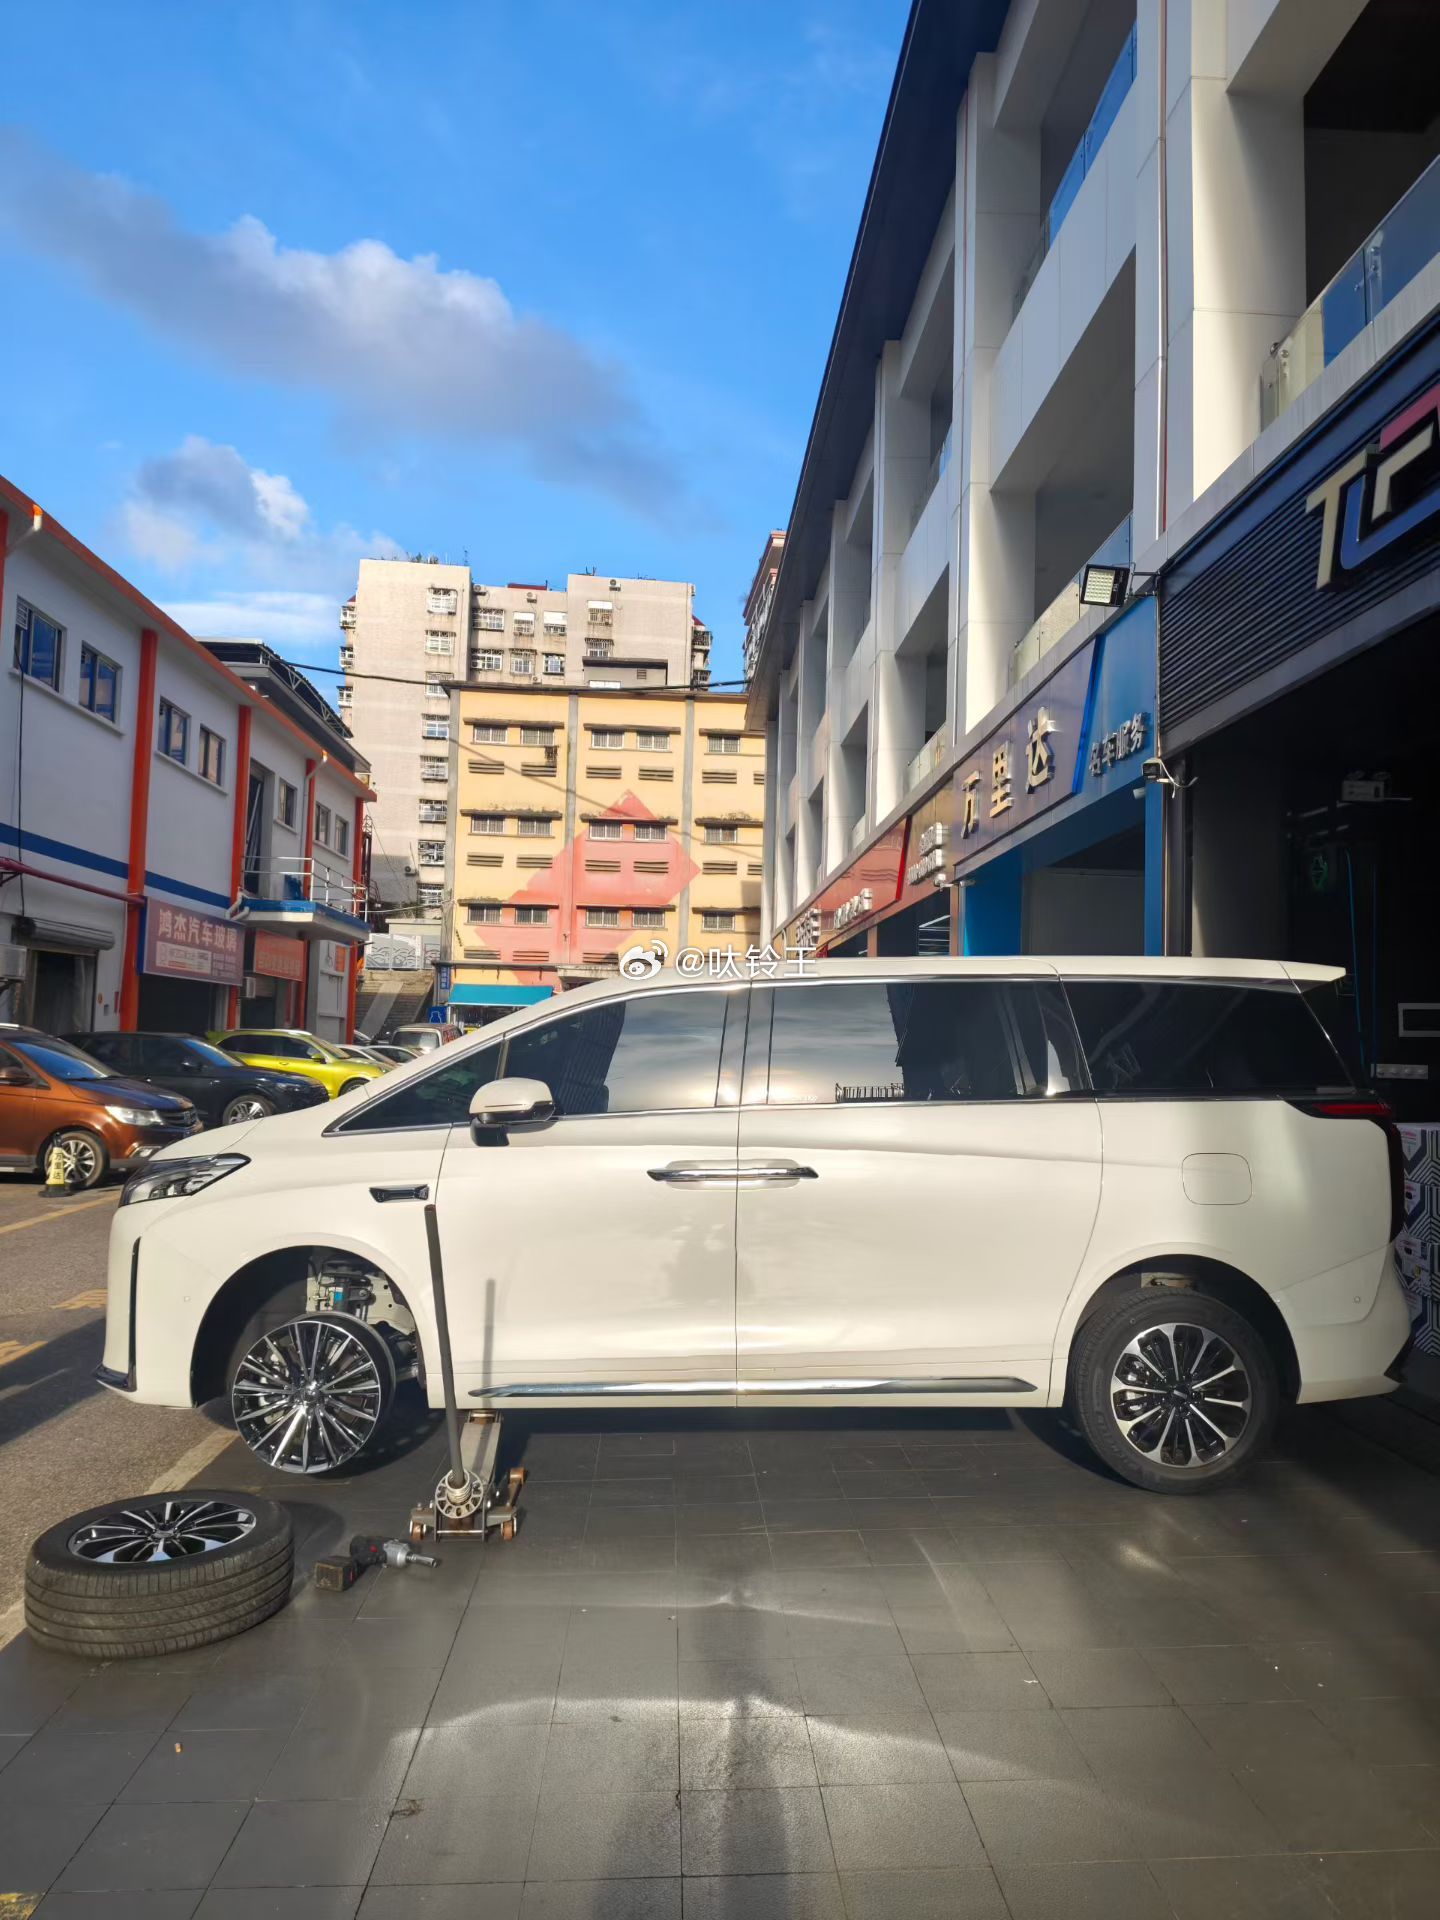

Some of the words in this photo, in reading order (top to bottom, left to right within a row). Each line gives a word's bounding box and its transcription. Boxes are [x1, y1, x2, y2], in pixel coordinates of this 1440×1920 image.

[961, 706, 1062, 839] 万里达
[1088, 712, 1148, 777] 名车服务
[158, 908, 238, 953] 鸿杰汽车玻璃
